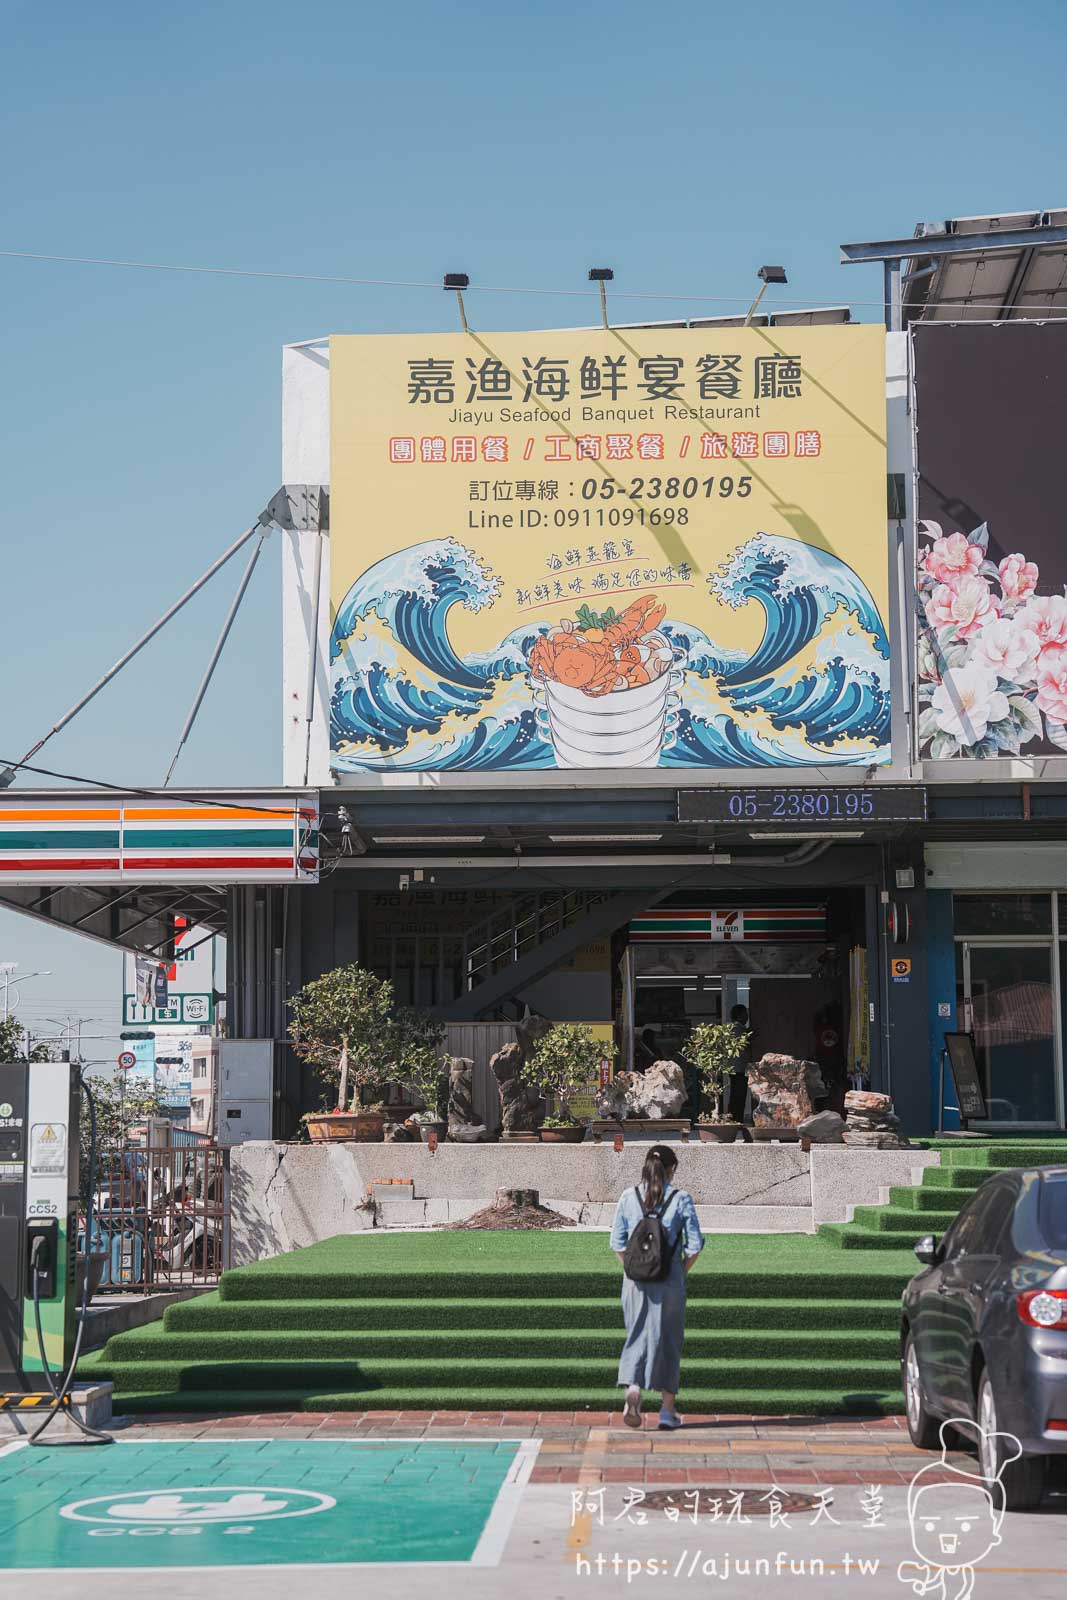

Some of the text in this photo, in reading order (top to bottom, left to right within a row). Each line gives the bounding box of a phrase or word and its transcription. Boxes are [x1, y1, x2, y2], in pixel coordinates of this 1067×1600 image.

[448, 404, 761, 426] Jiayu Seafood Banquet Restaurant
[389, 436, 509, 463] 團體用餐
[544, 433, 665, 462] 工商聚餐
[700, 430, 822, 459] 旅遊團膳
[468, 510, 514, 529] Line
[729, 793, 873, 816] 05-2380195
[122, 1056, 133, 1064] 50
[29, 1204, 57, 1214] CCS2
